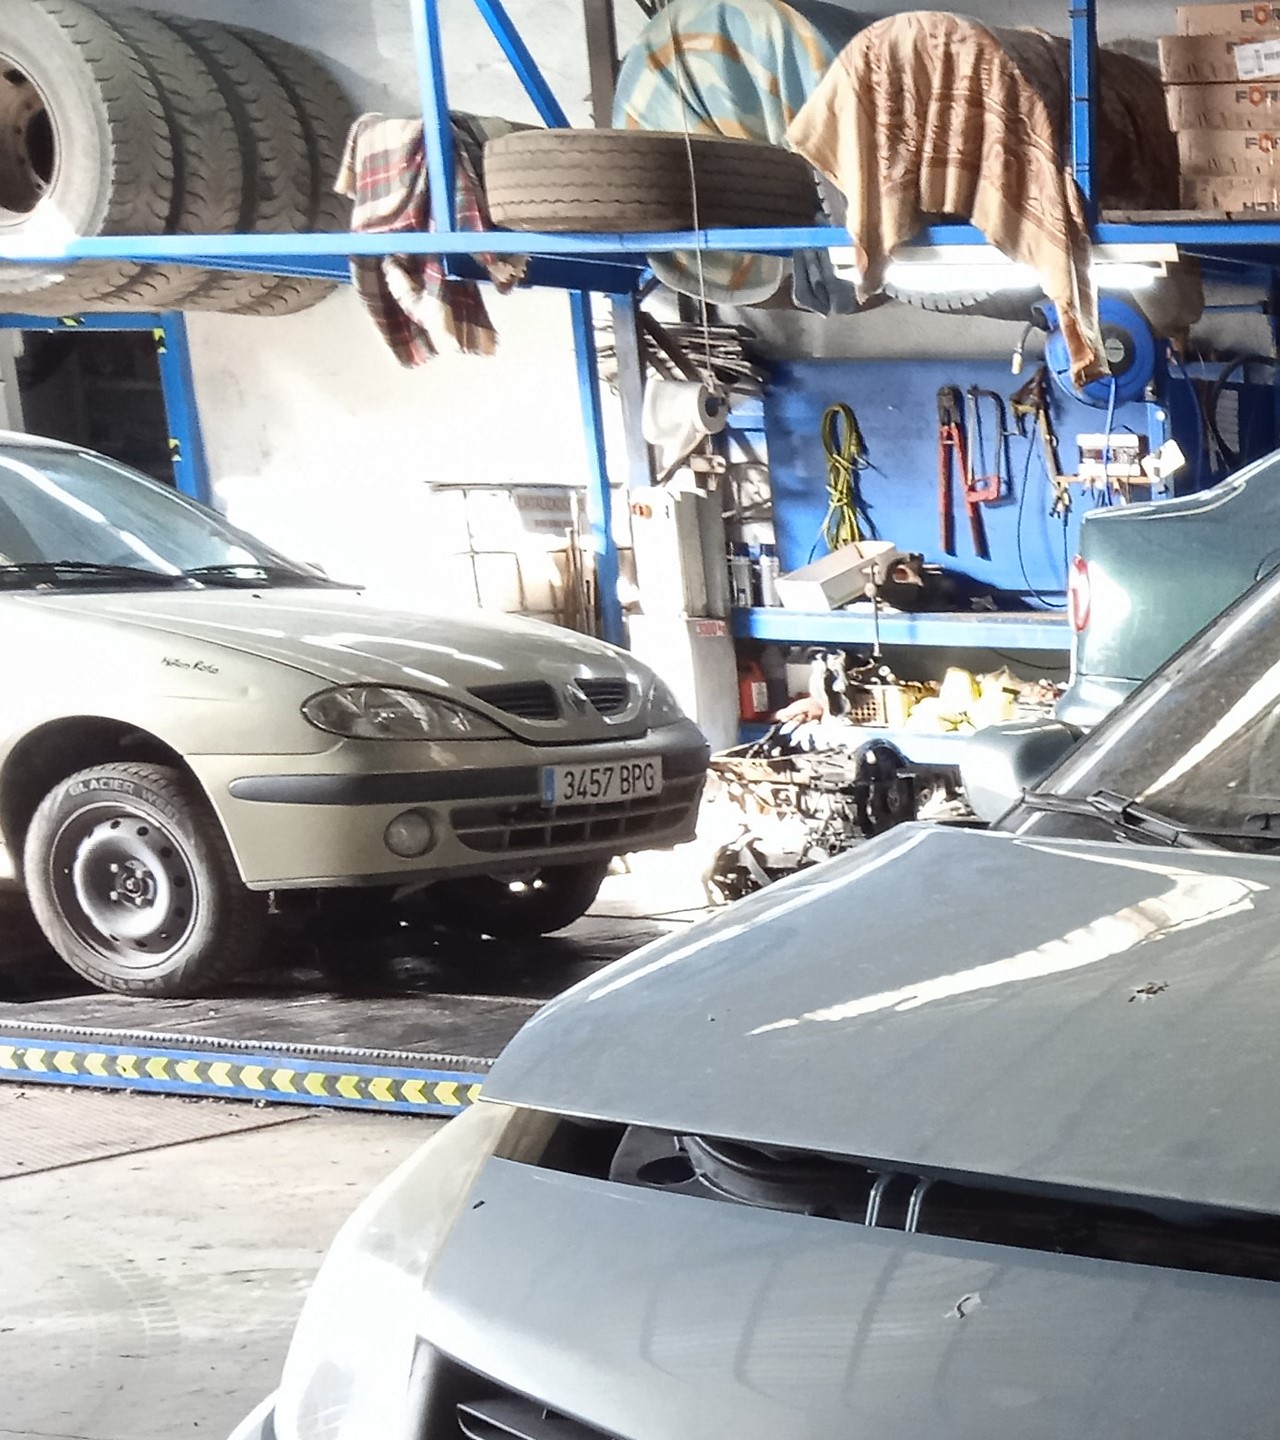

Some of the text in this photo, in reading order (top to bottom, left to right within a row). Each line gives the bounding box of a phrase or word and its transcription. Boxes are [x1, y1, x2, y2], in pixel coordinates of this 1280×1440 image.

[68, 775, 135, 797] GLACIER
[564, 763, 655, 801] 3457 BPG
